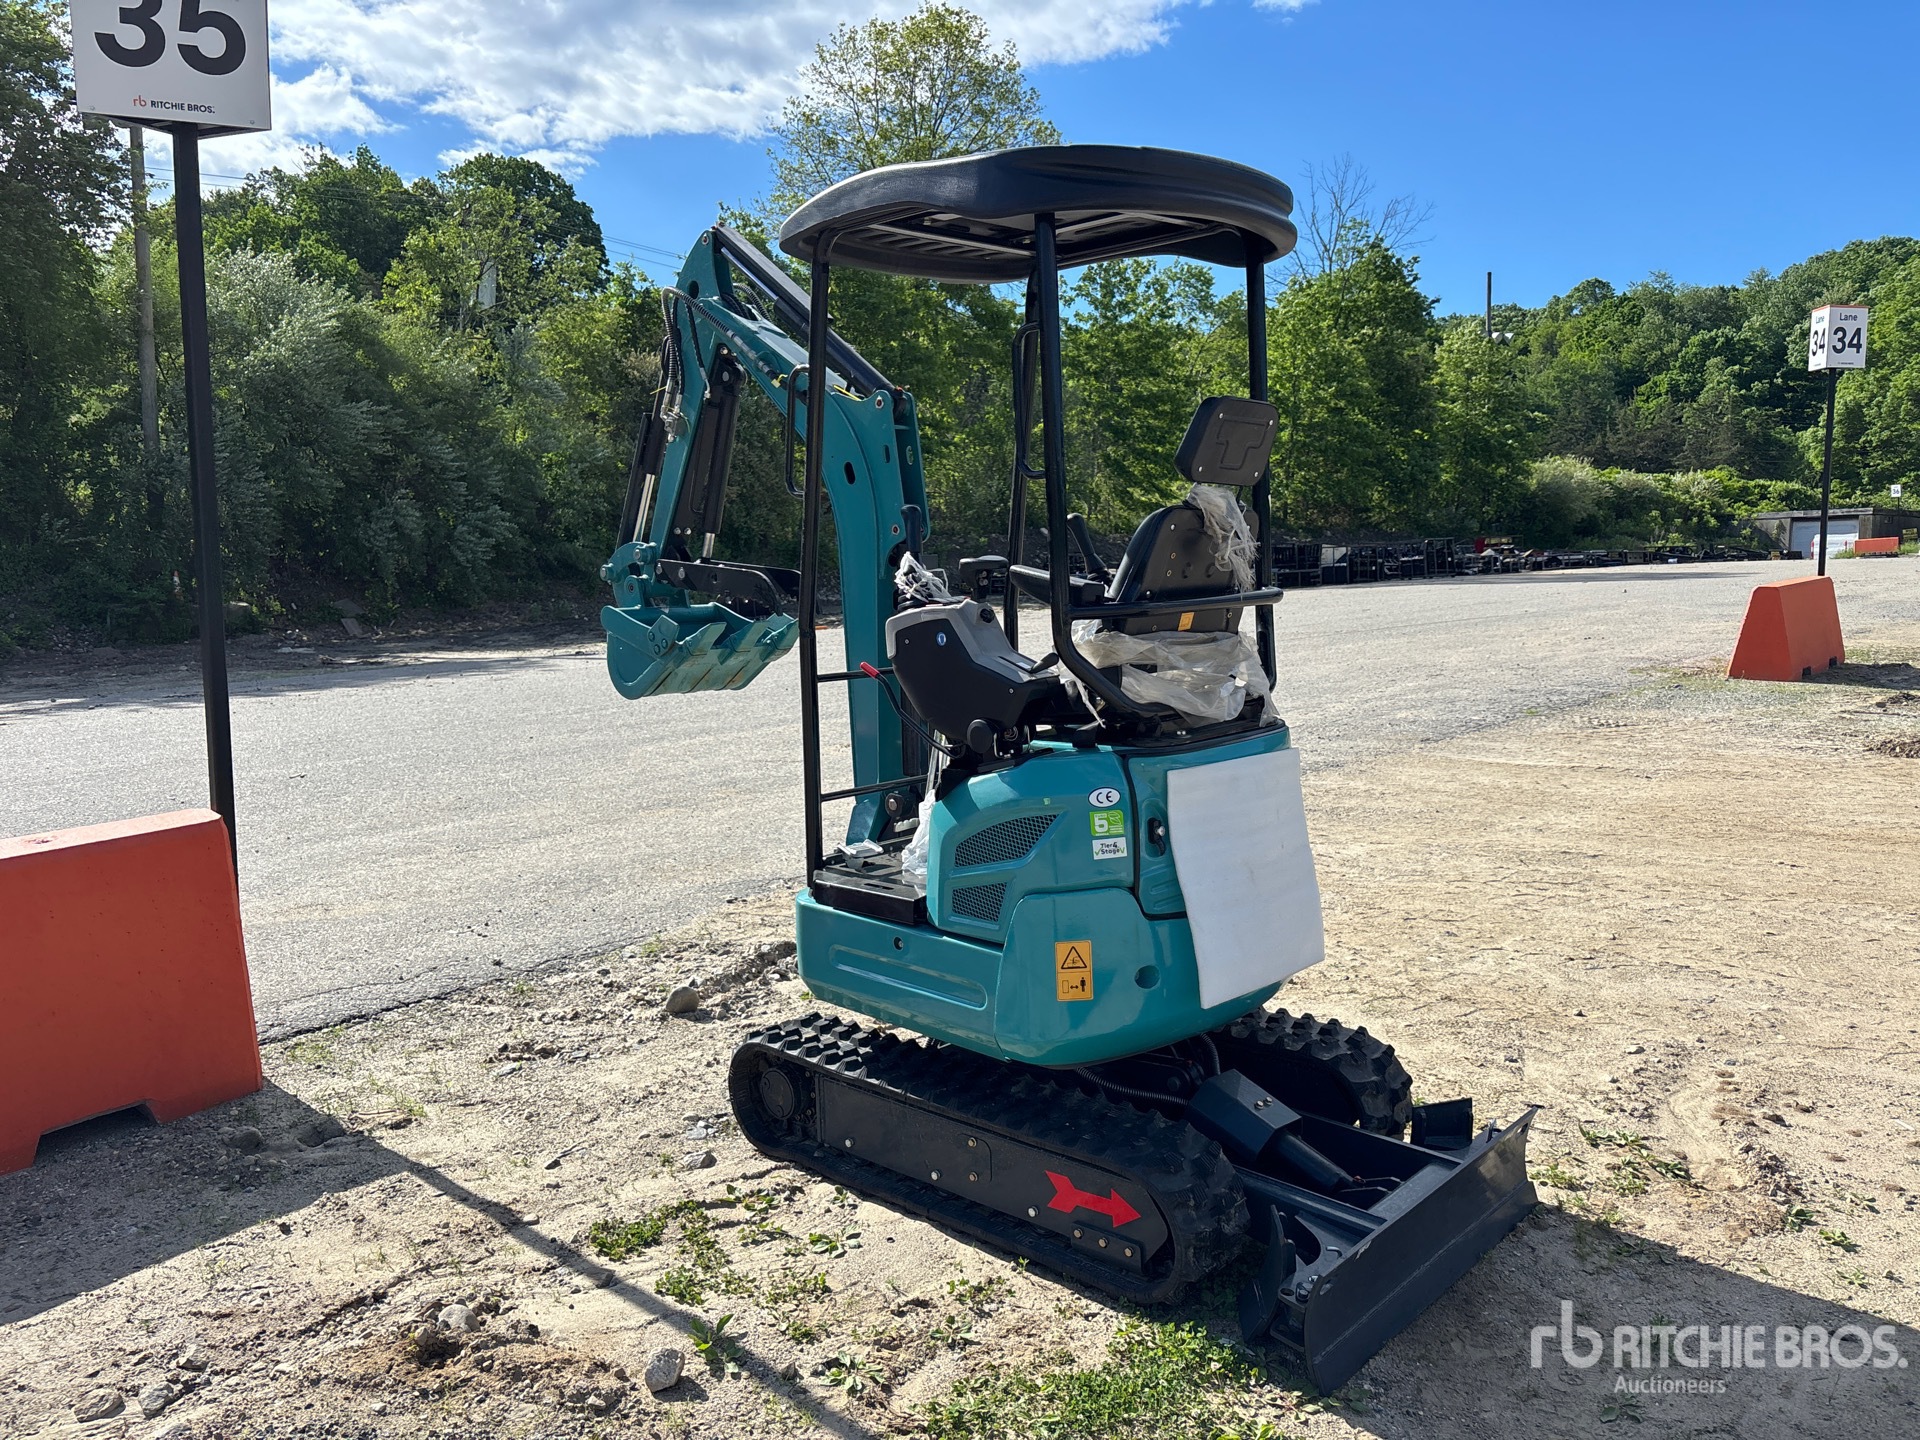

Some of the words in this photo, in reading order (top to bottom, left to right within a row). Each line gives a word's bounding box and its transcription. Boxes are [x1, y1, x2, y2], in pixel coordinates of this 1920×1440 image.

[94, 0, 246, 75] 35
[150, 100, 185, 111] RITCHIE
[187, 103, 215, 114] BROS.
[1815, 316, 1825, 324] Lane
[1840, 312, 1858, 321] Lane
[1811, 328, 1826, 356] 34
[1832, 326, 1862, 354] 34
[1096, 791, 1113, 804] CE
[1094, 812, 1108, 832] 5
